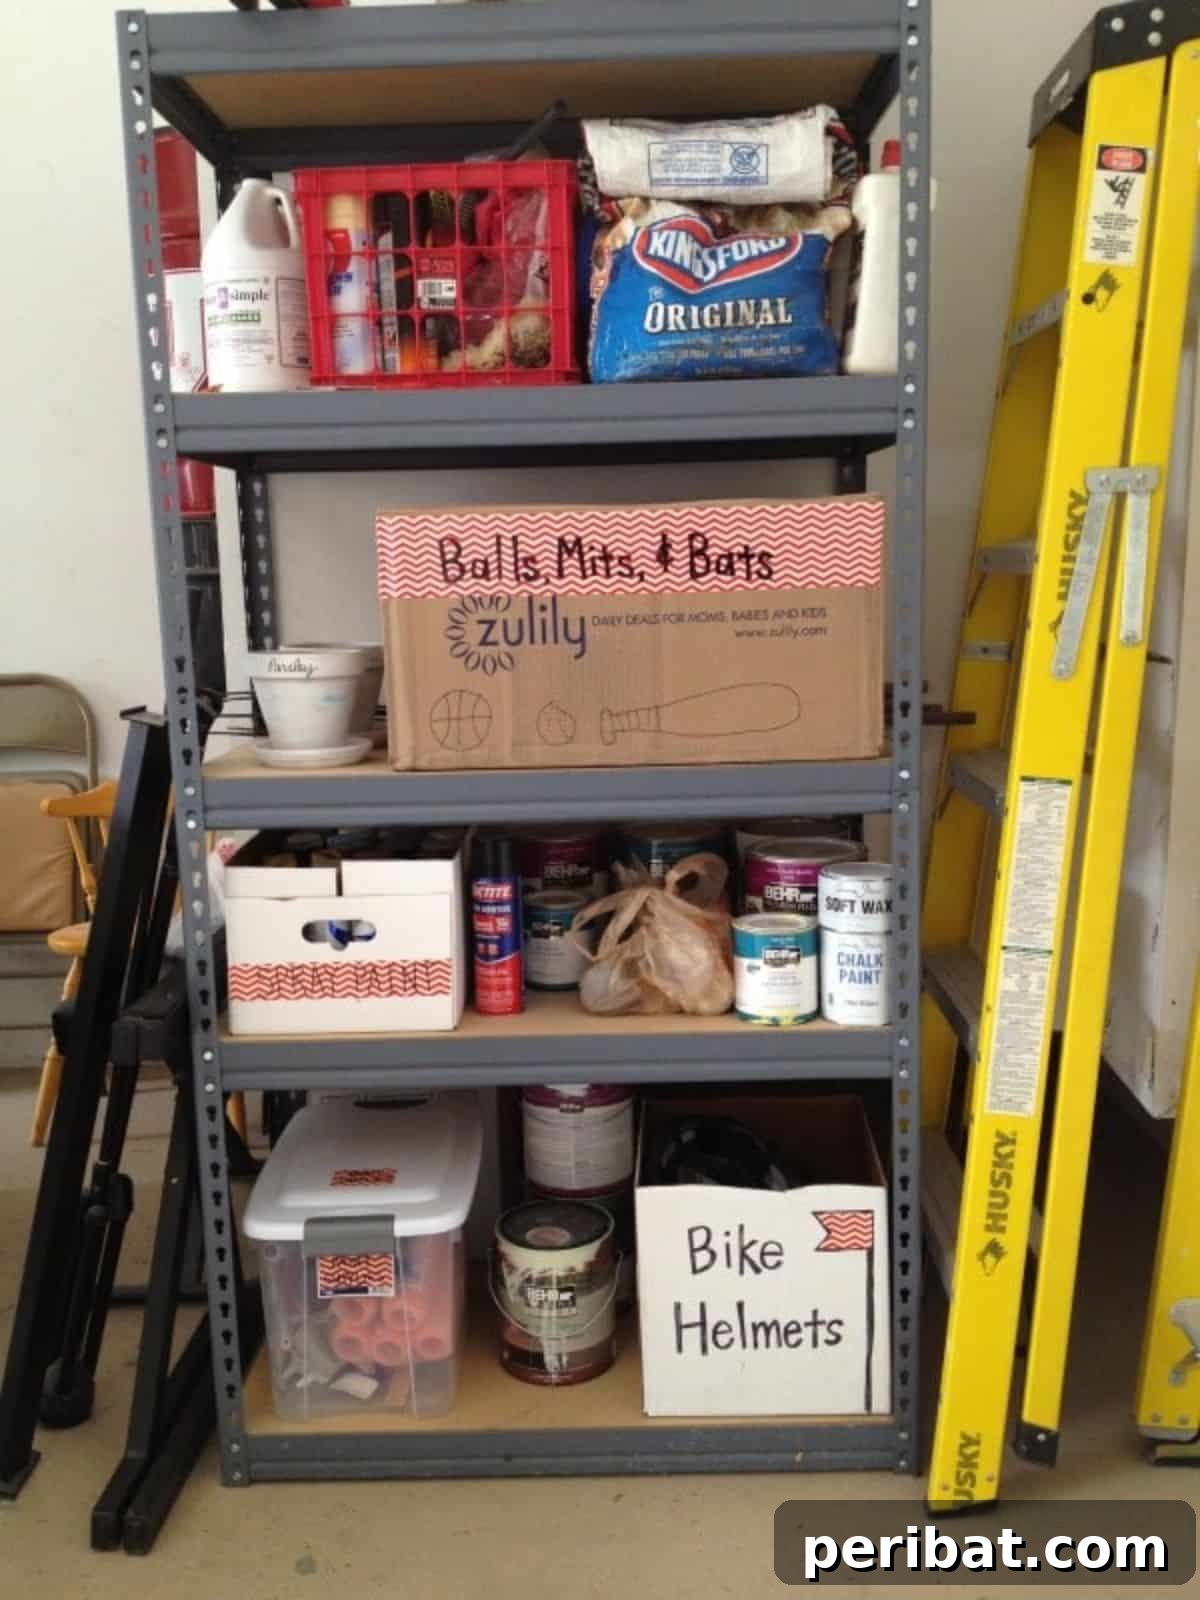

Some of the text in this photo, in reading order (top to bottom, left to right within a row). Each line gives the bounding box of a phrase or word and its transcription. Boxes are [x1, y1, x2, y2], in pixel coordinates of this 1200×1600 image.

[644, 297, 793, 333] ORIGINAL
[438, 533, 550, 584] Balls,
[557, 534, 646, 582] Mits,
[688, 531, 775, 582] Bats
[477, 593, 587, 660] zulily
[625, 612, 660, 625] DEALS
[662, 612, 685, 625] FOR
[731, 608, 769, 622] BABIES
[771, 608, 799, 620] AND
[800, 607, 827, 619] KIDS
[825, 896, 857, 914] SOFT
[861, 898, 893, 915] WAX
[837, 951, 883, 969] CHALK
[839, 968, 881, 985] PAINT
[984, 1128, 1017, 1235] HUSKY
[687, 1223, 784, 1276] Bike
[673, 1300, 845, 1357] Helmets
